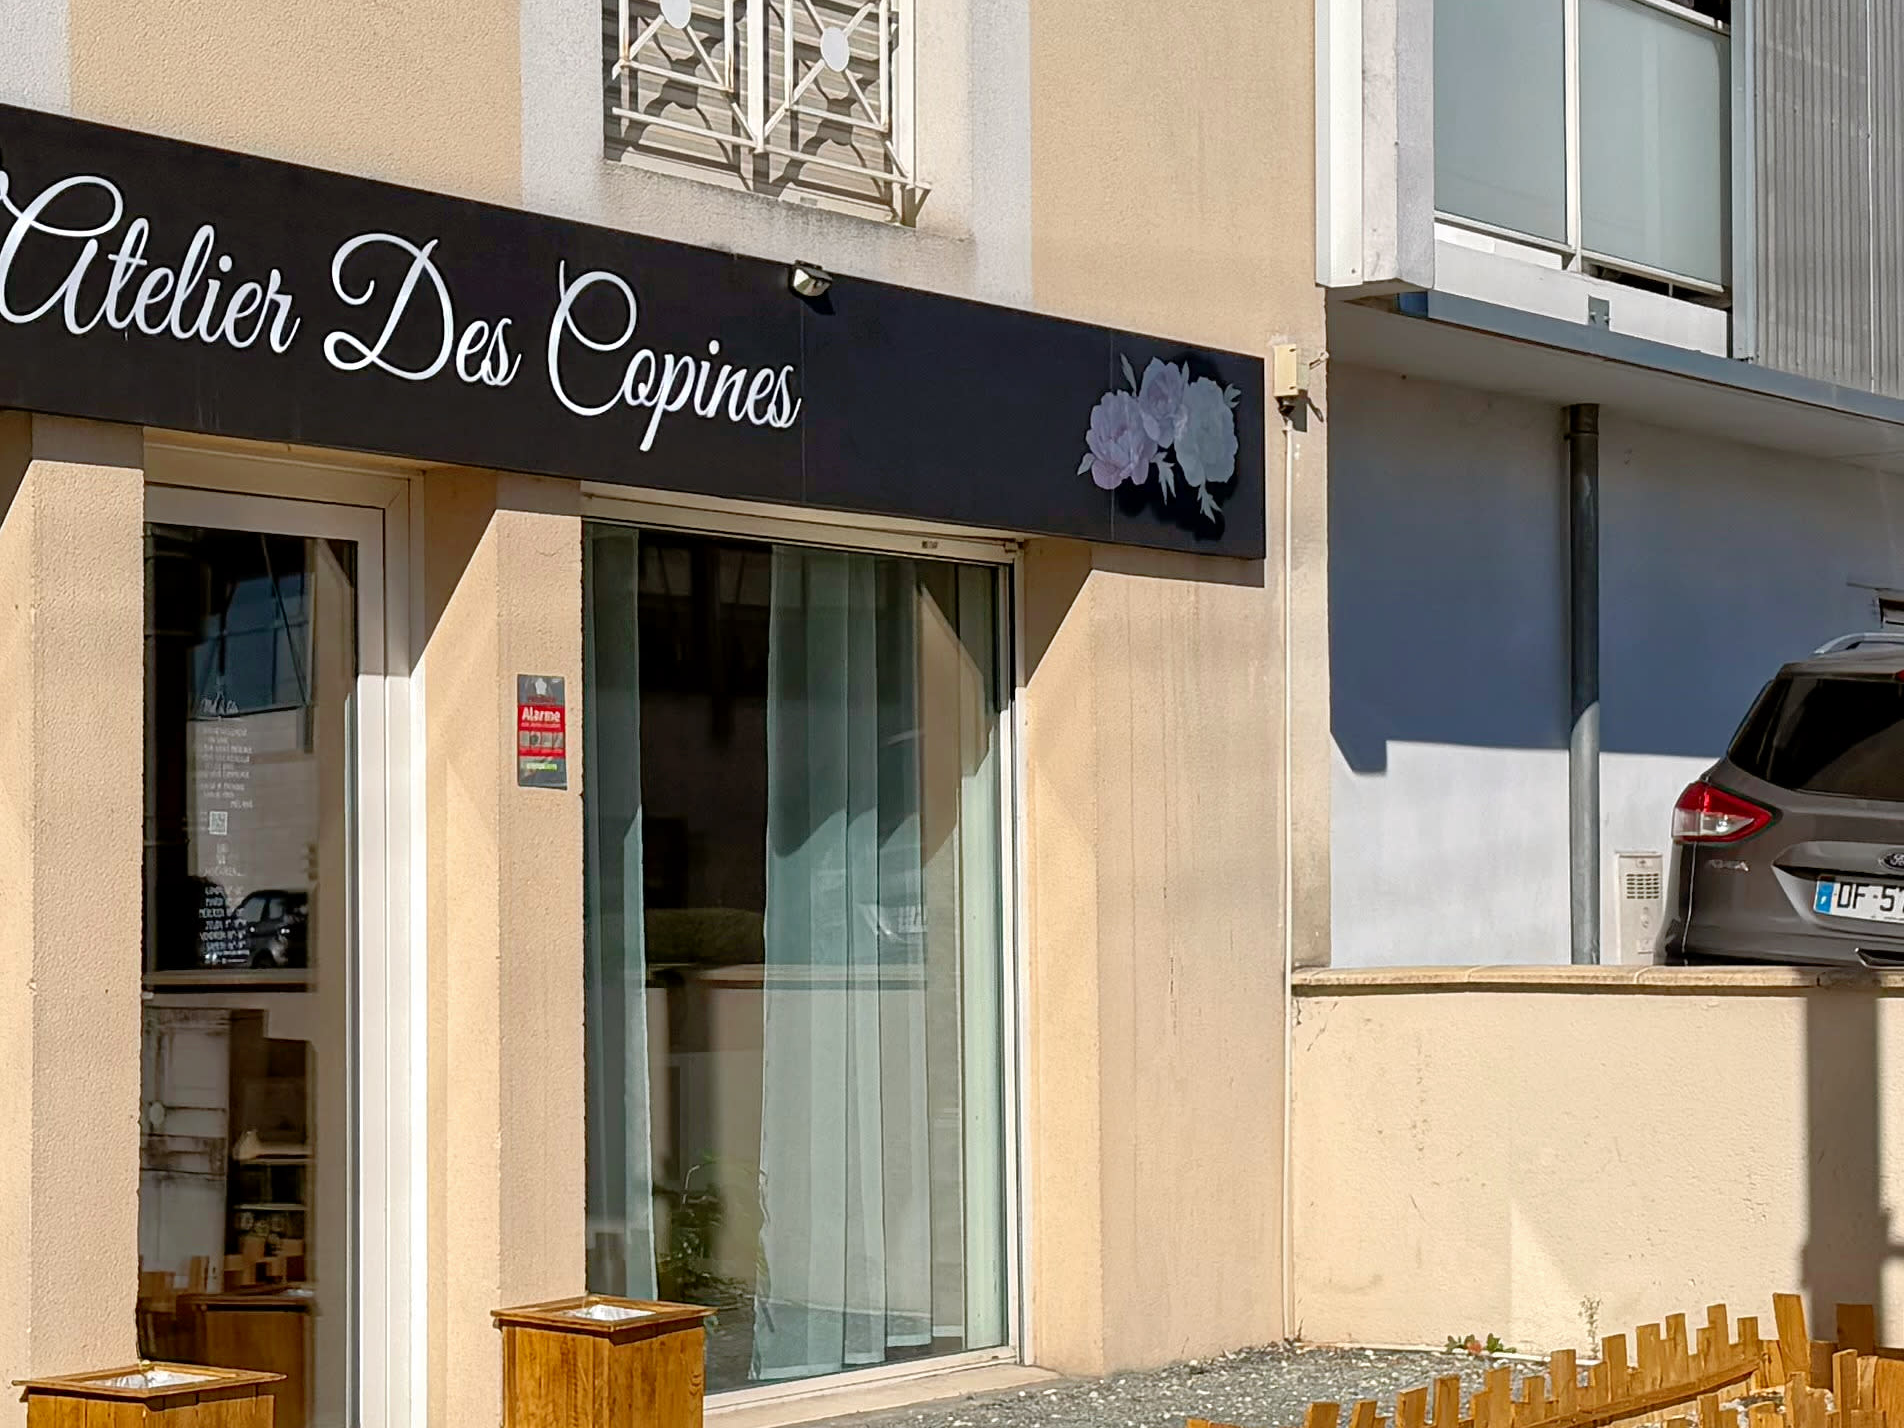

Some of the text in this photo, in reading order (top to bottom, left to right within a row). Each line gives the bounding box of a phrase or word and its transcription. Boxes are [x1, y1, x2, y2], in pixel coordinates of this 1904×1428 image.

[322, 232, 523, 387] Des
[547, 259, 801, 452] Copines
[522, 707, 560, 722] Alarme
